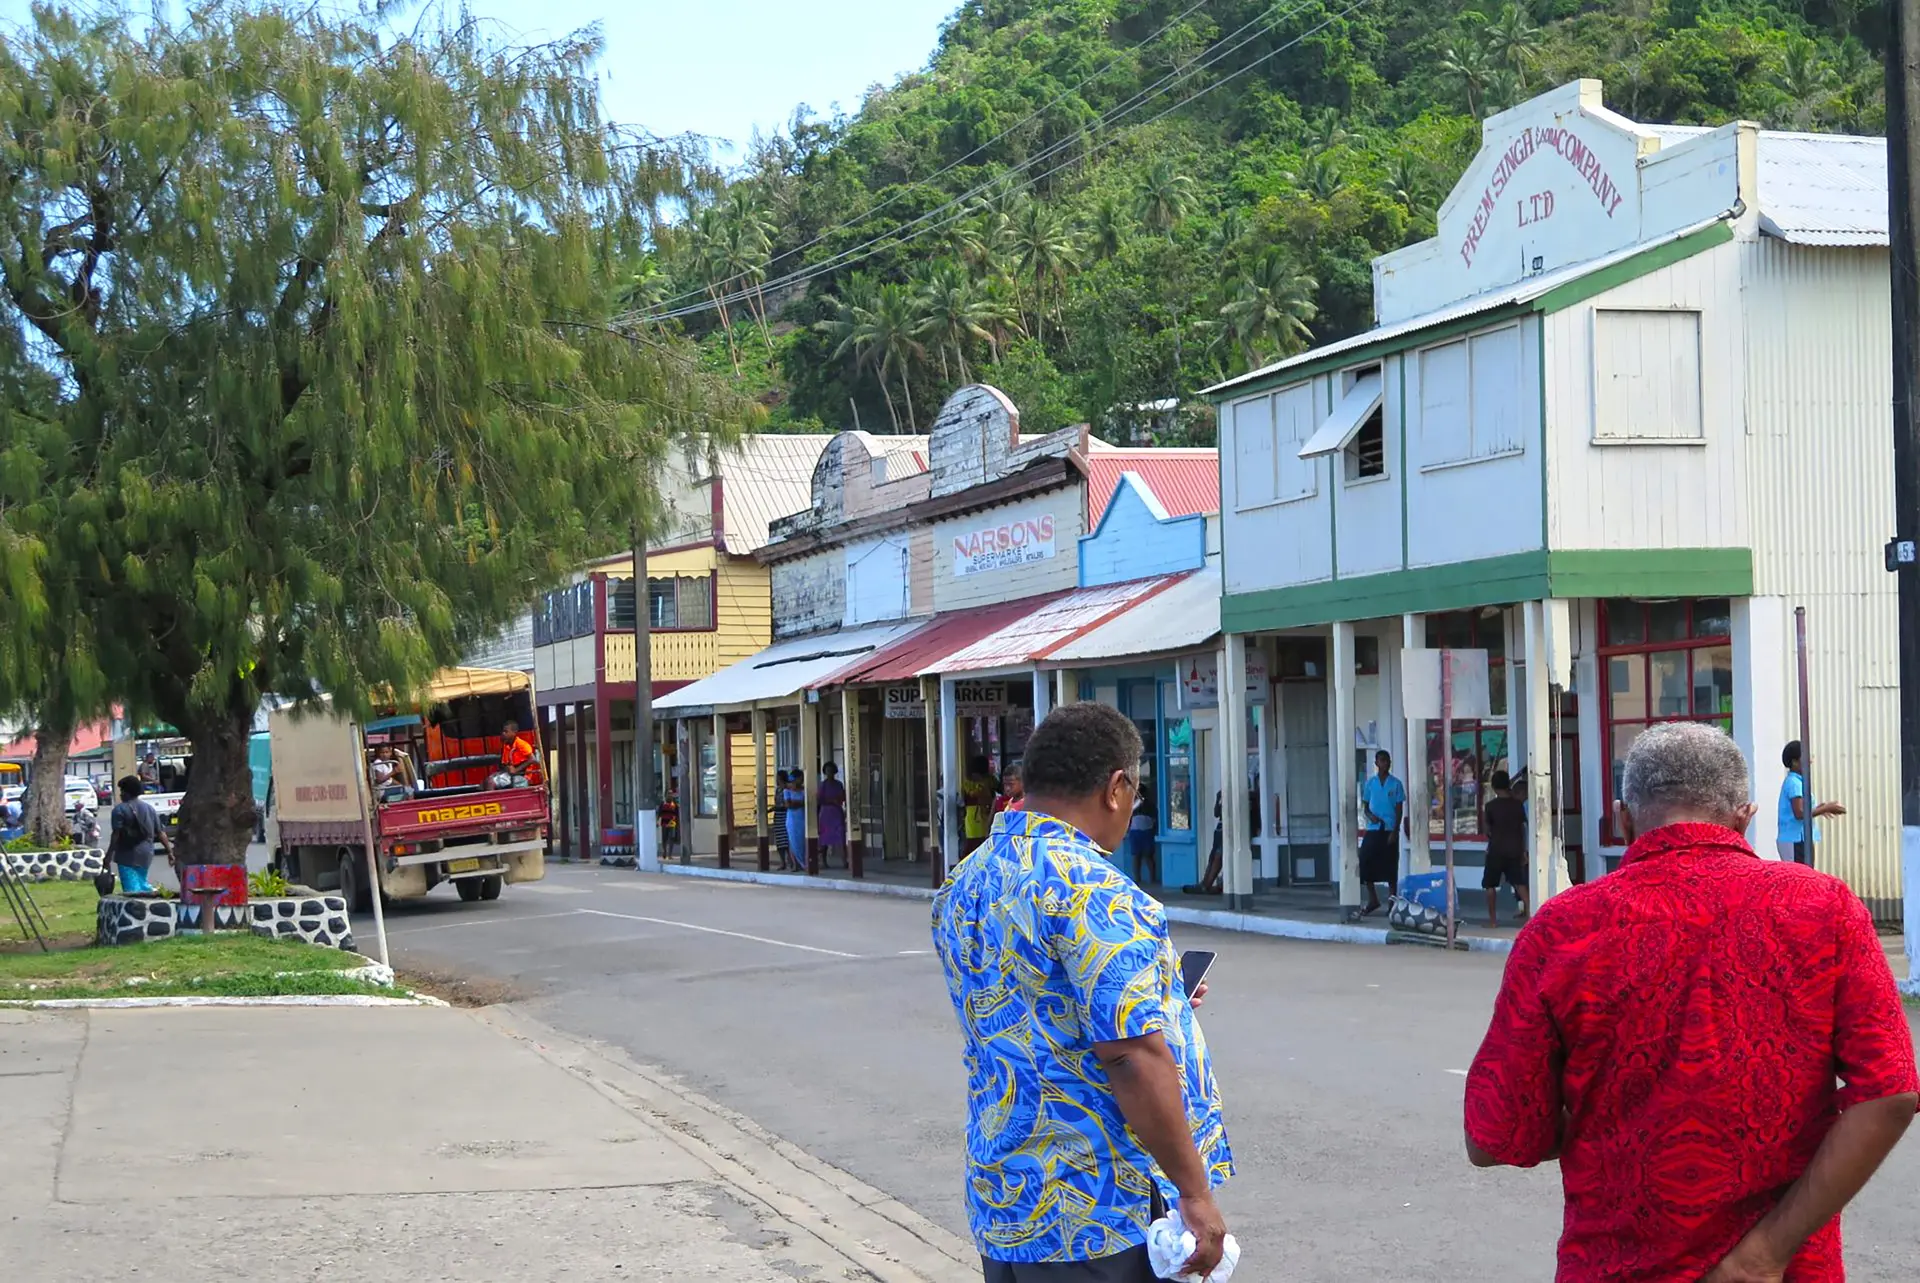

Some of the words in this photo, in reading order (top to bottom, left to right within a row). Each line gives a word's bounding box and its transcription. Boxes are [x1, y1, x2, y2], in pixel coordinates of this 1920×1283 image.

[1460, 186, 1495, 269] PREM
[1491, 127, 1535, 199] SINGH
[1556, 128, 1623, 219] COMPANY
[955, 515, 1053, 560] NARSONS
[973, 545, 1028, 565] SUPERMARKET
